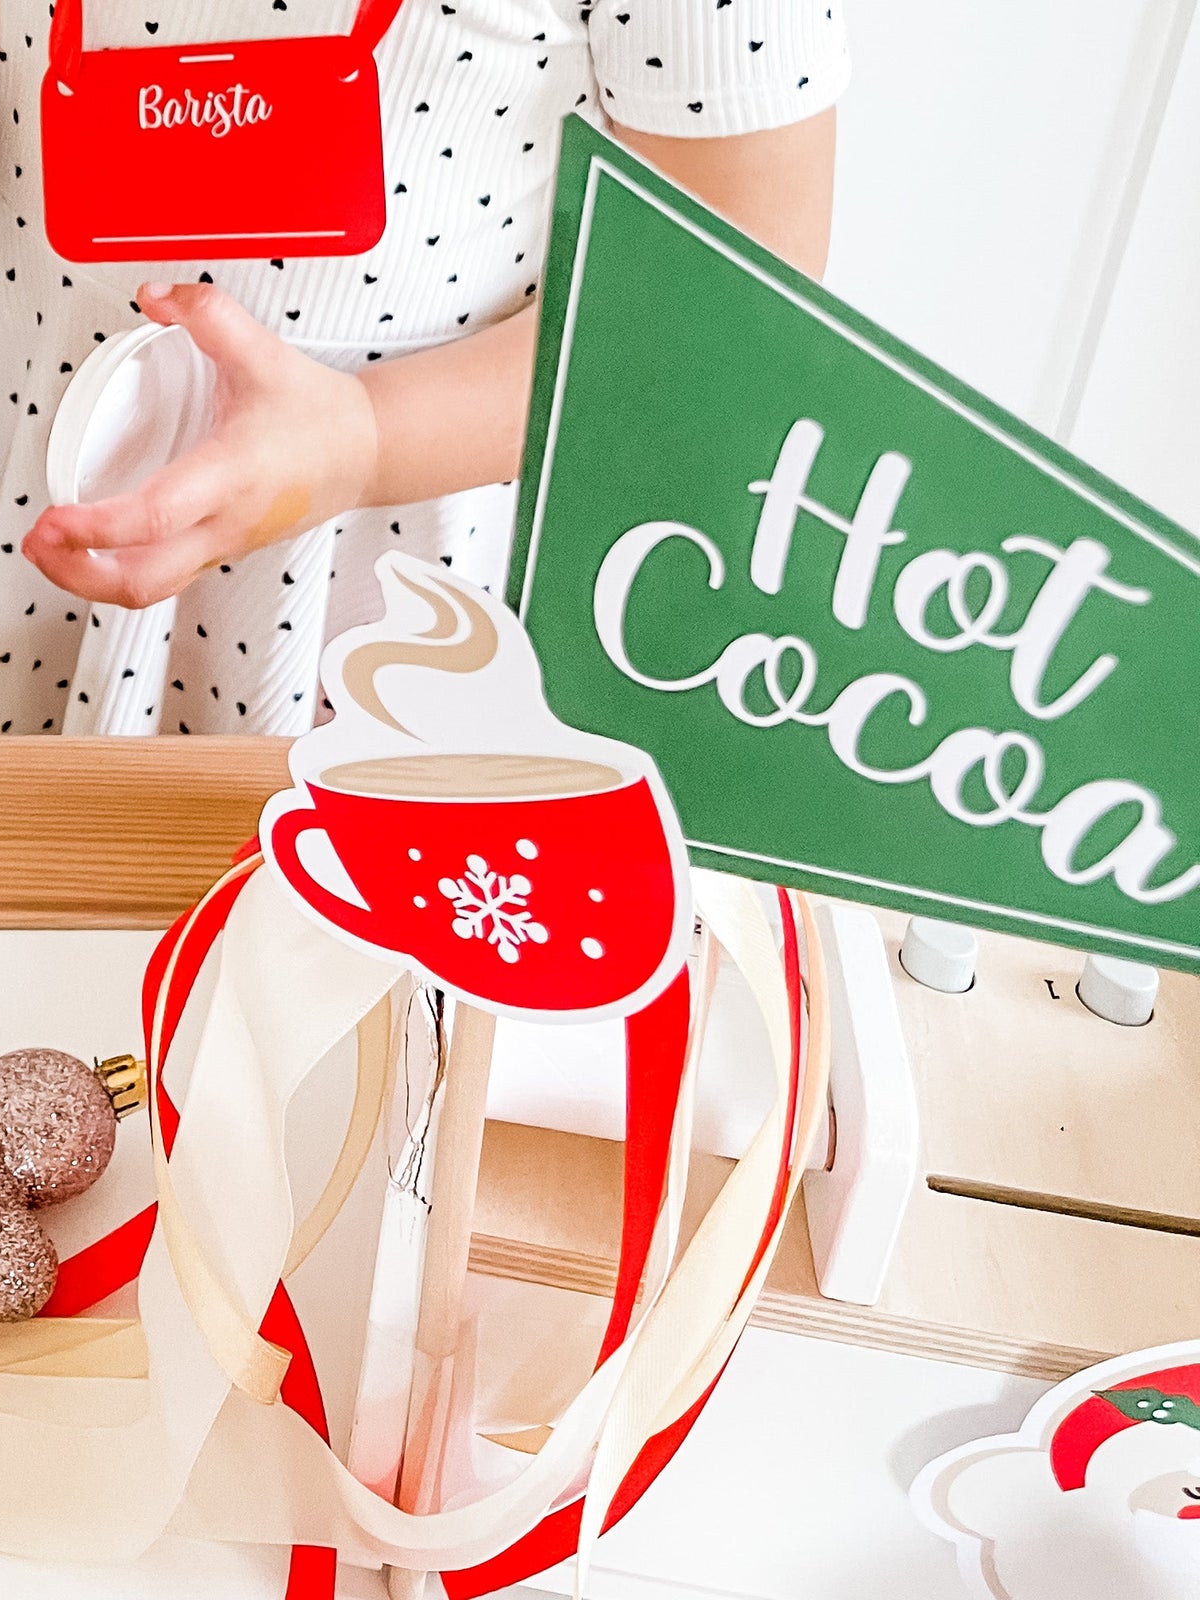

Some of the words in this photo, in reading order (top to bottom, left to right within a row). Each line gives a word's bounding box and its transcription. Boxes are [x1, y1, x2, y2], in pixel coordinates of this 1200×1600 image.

[138, 83, 273, 138] Barista
[593, 521, 1200, 903] Cocoa
[747, 418, 1152, 719] Hot
